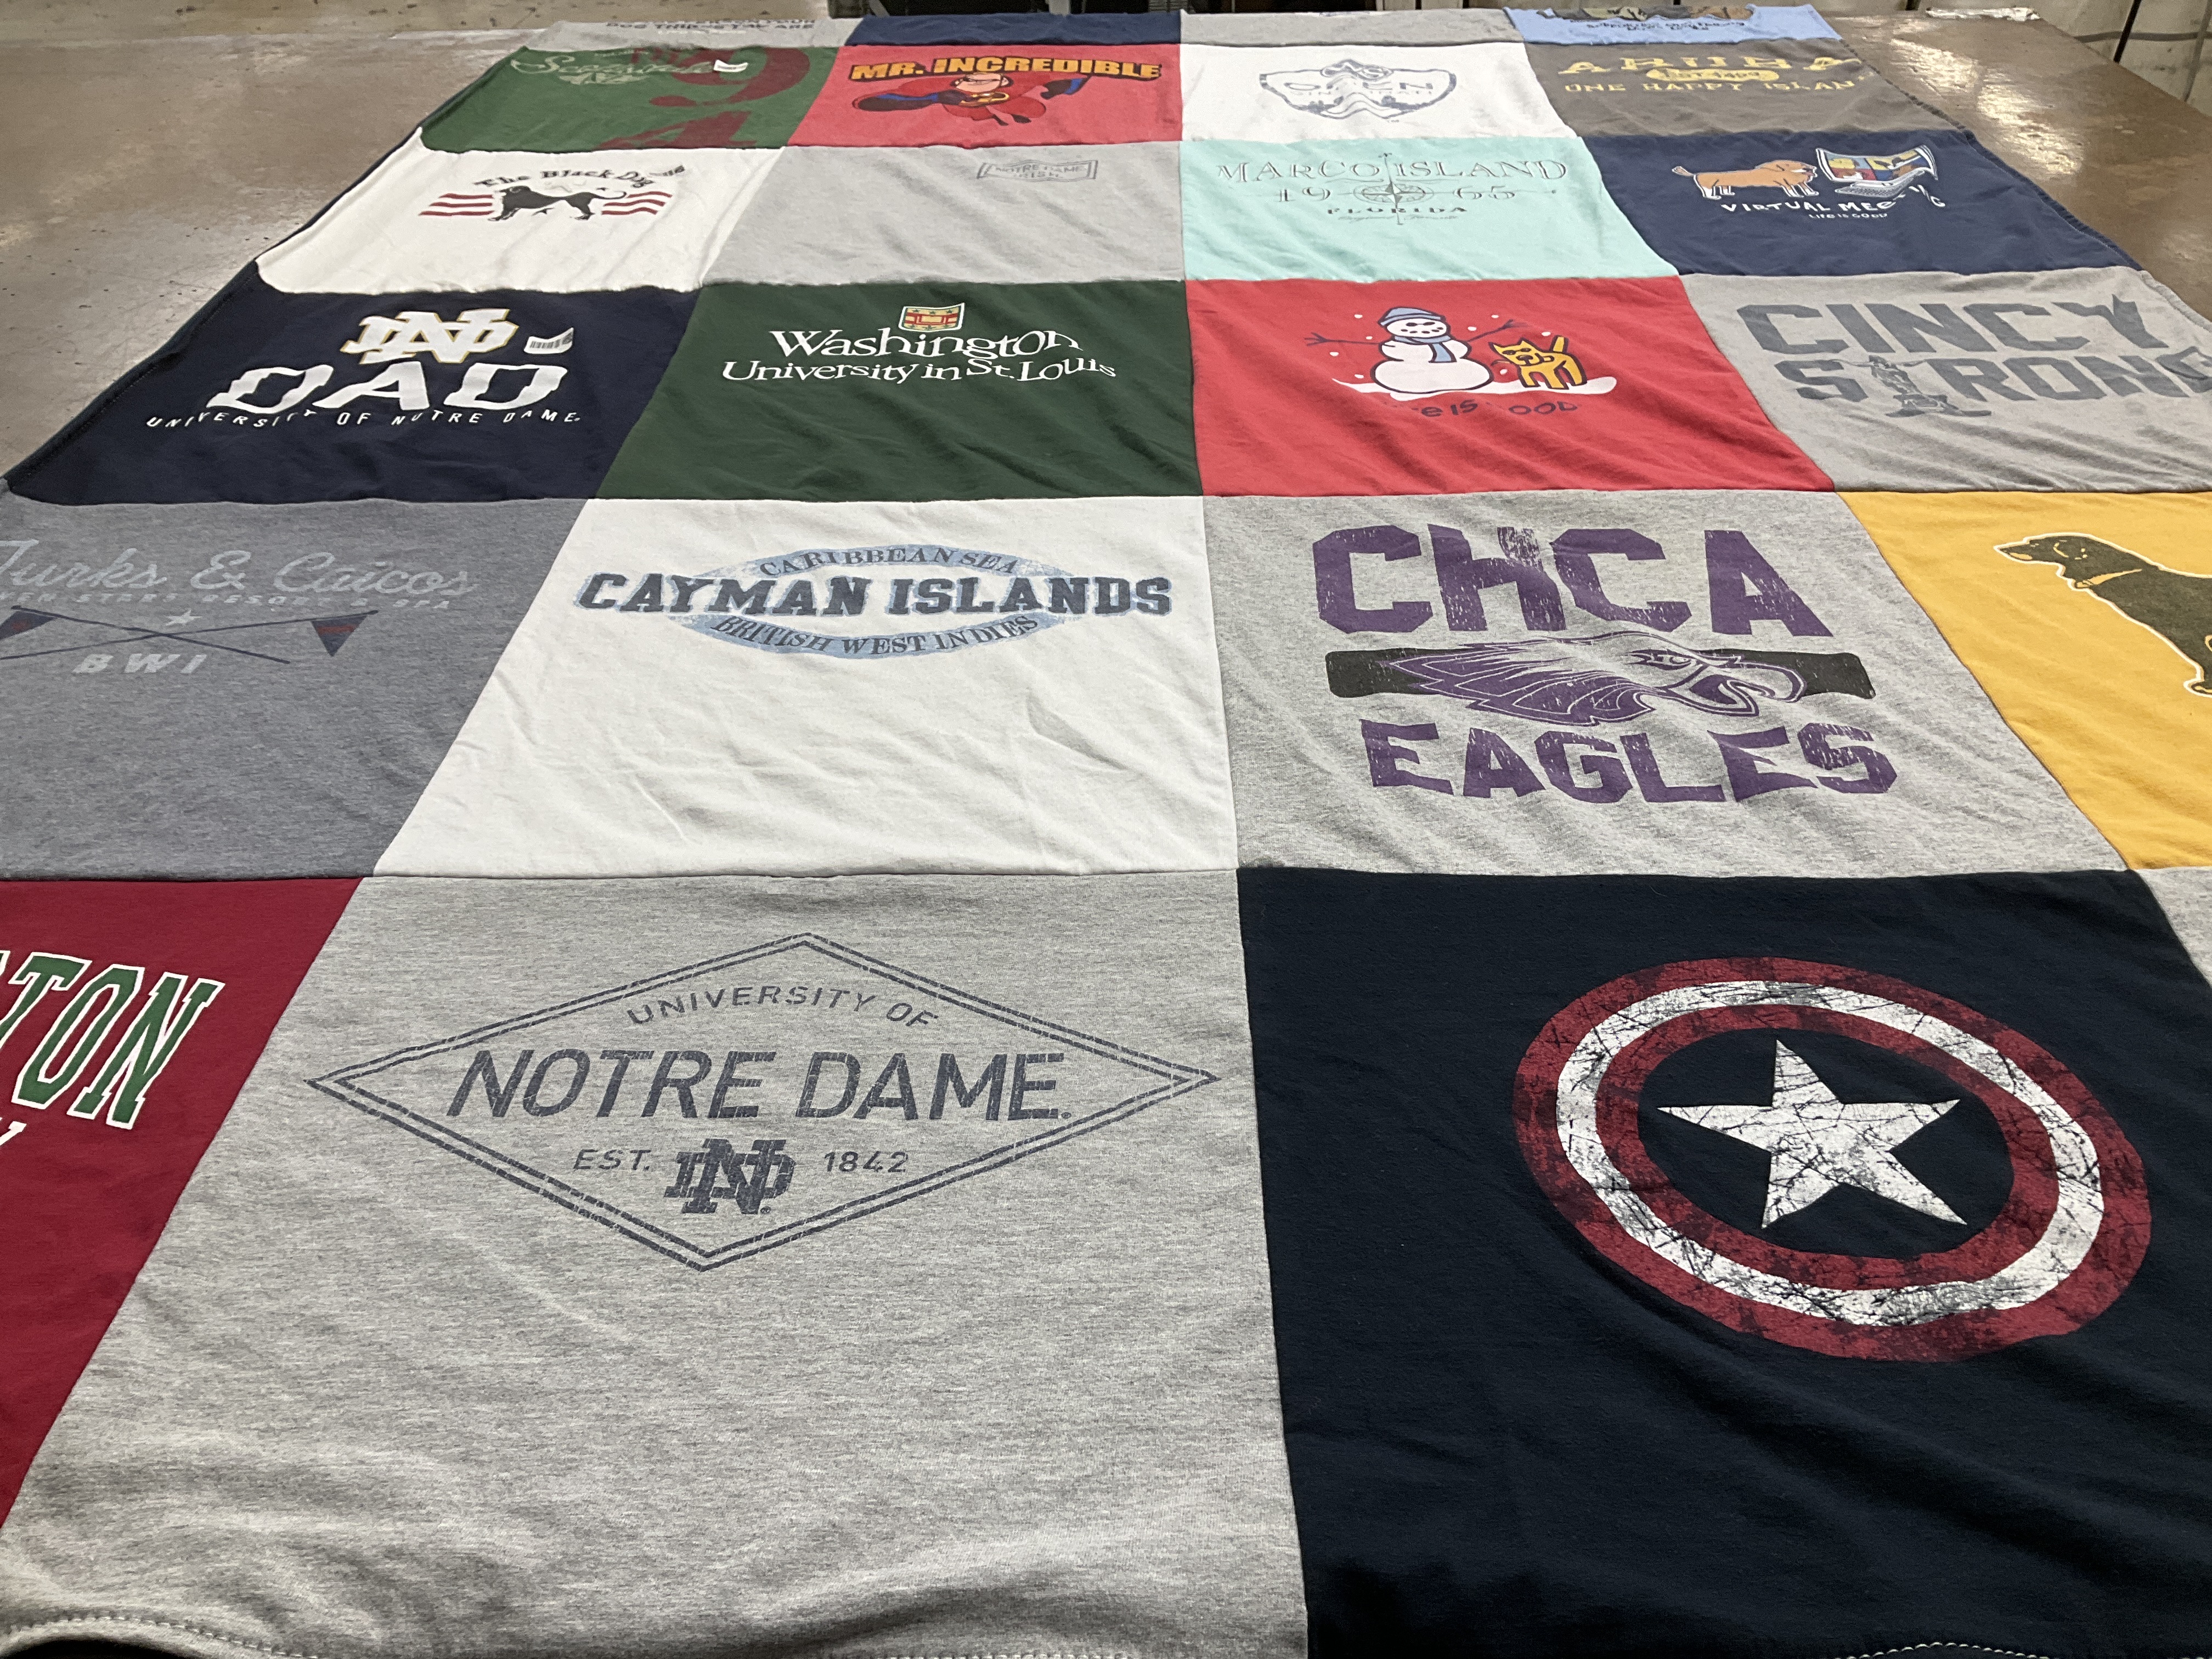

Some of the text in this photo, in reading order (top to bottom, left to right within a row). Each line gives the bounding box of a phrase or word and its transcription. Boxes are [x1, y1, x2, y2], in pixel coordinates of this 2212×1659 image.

[850, 57, 1162, 81] MR. INCREDIBLE
[1564, 83, 1626, 92] ONE
[1643, 82, 1744, 92] HAPPY
[473, 169, 655, 188] The Black Dog
[1216, 160, 1568, 183] MARCO ISLAND
[1720, 201, 1831, 212] VIRTUAL
[1737, 294, 2169, 355] CINCY
[769, 328, 1083, 359] Washington
[722, 356, 1117, 384] University in St. Louis
[206, 360, 568, 414] DAD
[146, 408, 317, 428] UNIVERSITY
[336, 412, 372, 426] OF
[503, 409, 576, 425] DAME
[0, 539, 478, 596] Turks & Caicos
[759, 548, 1019, 577] CARIBBEAN SEA
[576, 572, 1172, 616] CAYMAN ISLANDS
[1313, 523, 1833, 637] CHCA
[710, 614, 1039, 655] BRITISH WEST INDIES
[72, 653, 207, 674] BWI
[1360, 719, 1898, 804] EAGLES
[627, 985, 940, 1029] UNIVERSITY OF
[0, 950, 225, 1130] TON
[446, 1048, 1064, 1121] NOTRE DAME
[573, 1148, 652, 1171] EST.
[823, 1150, 909, 1173] 1842
